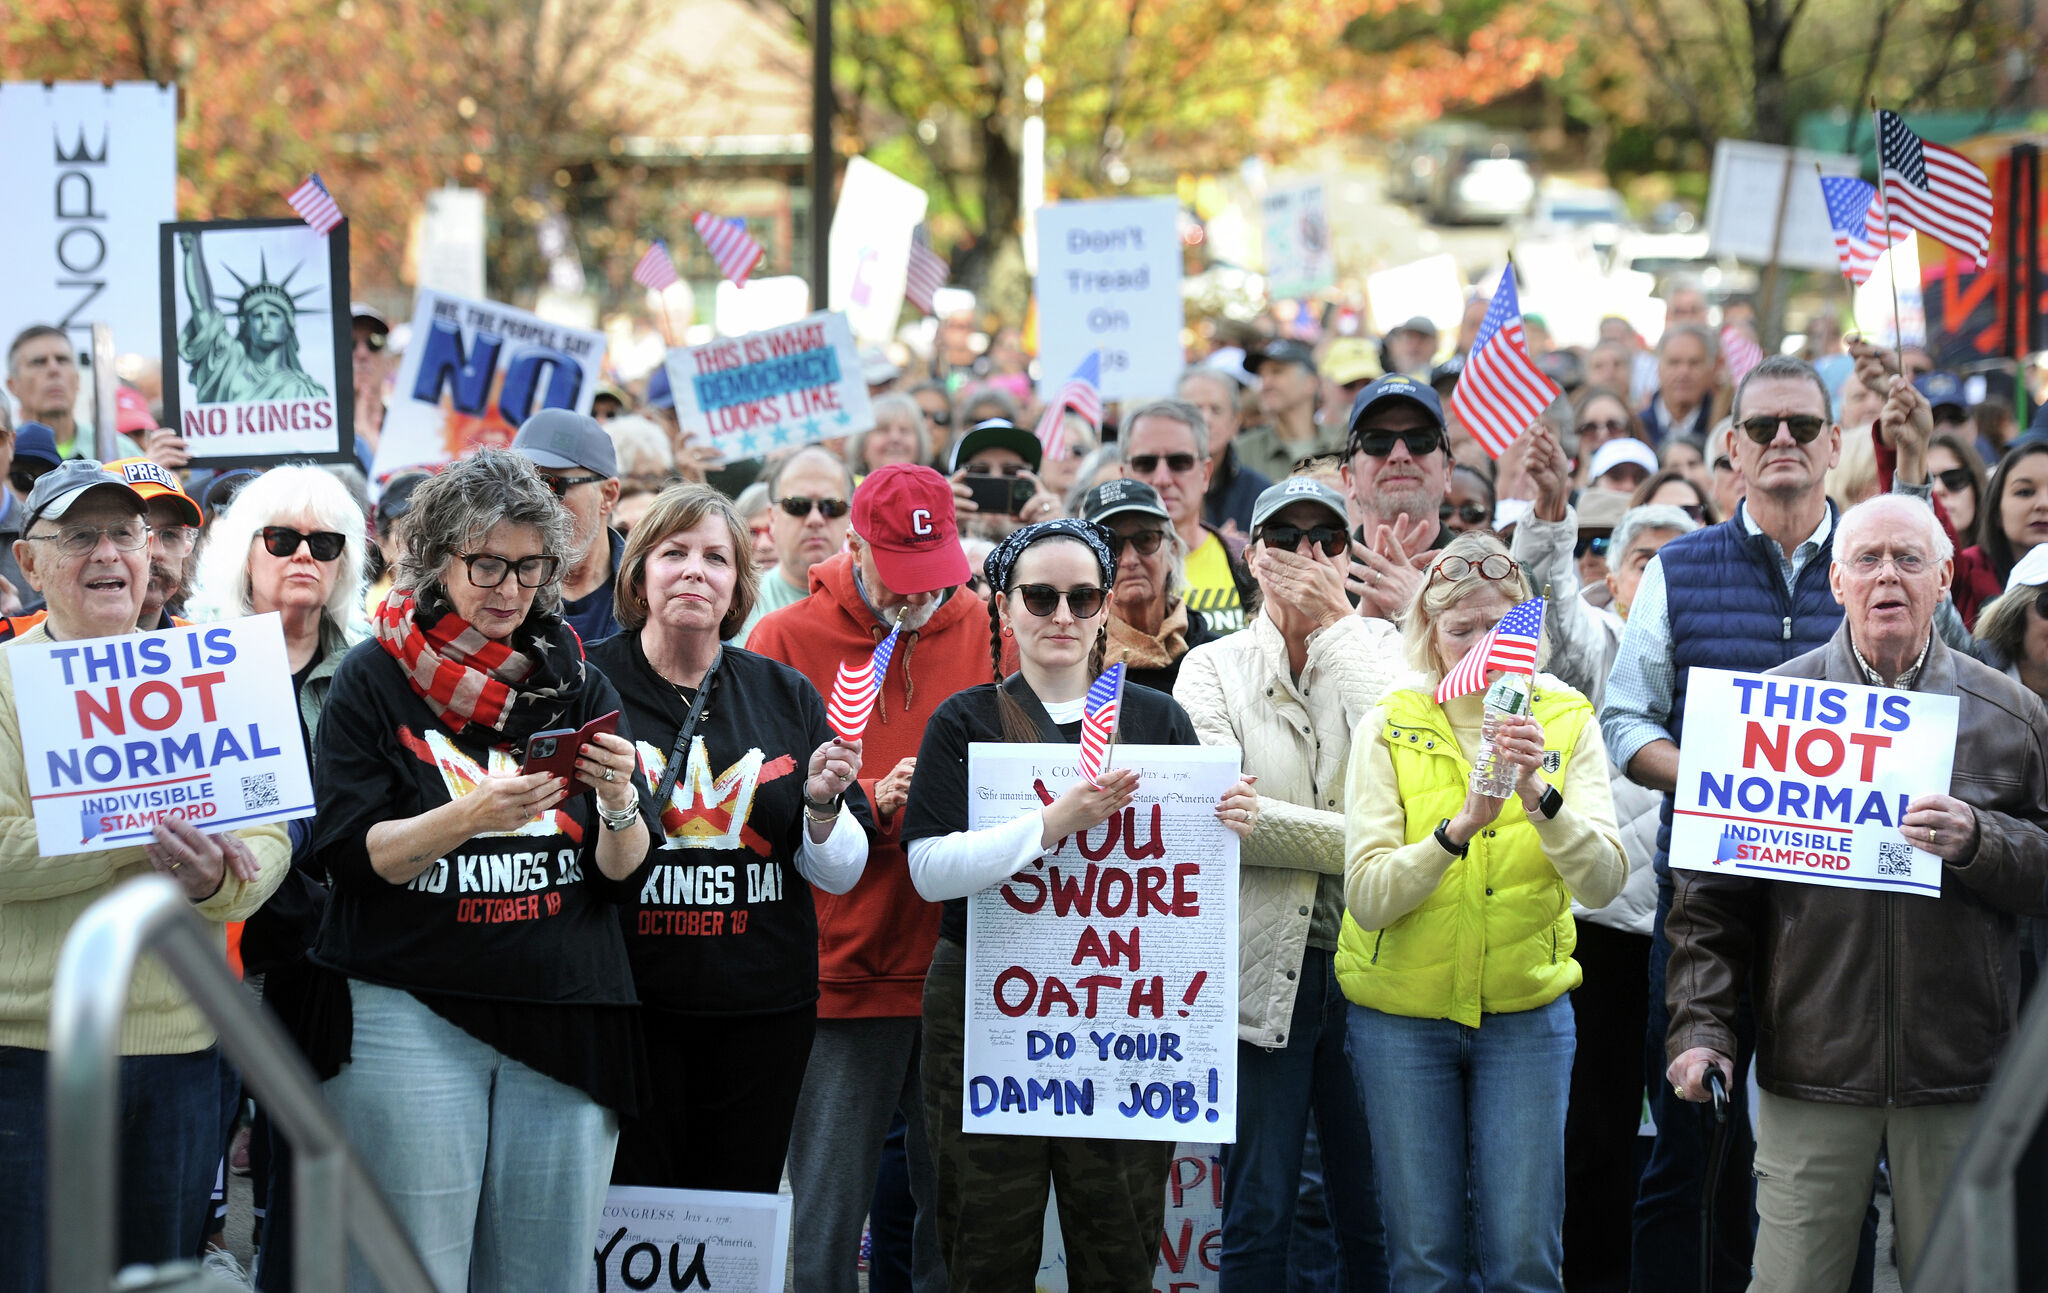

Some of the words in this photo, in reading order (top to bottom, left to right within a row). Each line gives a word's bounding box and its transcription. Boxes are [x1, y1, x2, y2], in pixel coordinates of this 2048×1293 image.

[1067, 225, 1144, 254] Don't
[1065, 264, 1150, 293] Tread
[501, 316, 556, 347] PEOPLE
[564, 334, 592, 356] SAY
[1088, 307, 1130, 333] On
[693, 341, 742, 374] THIS
[744, 337, 767, 364] IS
[767, 322, 826, 358] WHAT
[413, 319, 584, 428] NO
[699, 353, 833, 405] DEMOCRACY
[184, 408, 228, 438] NO
[236, 401, 333, 434] KINGS
[705, 395, 781, 437] LOOKS
[785, 381, 842, 418] LIKE
[126, 463, 175, 487] PRESS
[913, 509, 932, 535] C
[51, 637, 171, 685] THIS
[188, 628, 237, 668] IS
[75, 671, 225, 739] NOT
[1733, 678, 1848, 724] THIS
[1864, 693, 1911, 731] IS
[46, 723, 281, 788] NORMAL
[1742, 721, 1892, 783] NOT
[82, 782, 214, 814] INDIVISIBLE
[1000, 791, 1041, 801] unanimo
[100, 801, 217, 833] STAMFORD
[1724, 824, 1852, 853] INDIVISIBLE
[1736, 844, 1850, 871] STAMFORD
[457, 852, 549, 893] KINGS
[640, 865, 735, 905] KINGS
[1000, 858, 1200, 918] SWORE
[457, 894, 540, 924] OCTOBER
[544, 892, 562, 917] 18
[638, 910, 724, 936] OCTOBER
[730, 910, 748, 935] 18
[1071, 925, 1140, 972] AN
[993, 965, 1207, 1019] OATH!
[1027, 1030, 1076, 1061] DO
[1089, 1031, 1183, 1062] YOUR
[969, 1075, 1094, 1117] DAMN
[1118, 1067, 1219, 1124] JOB!
[594, 1226, 711, 1293] YOU
